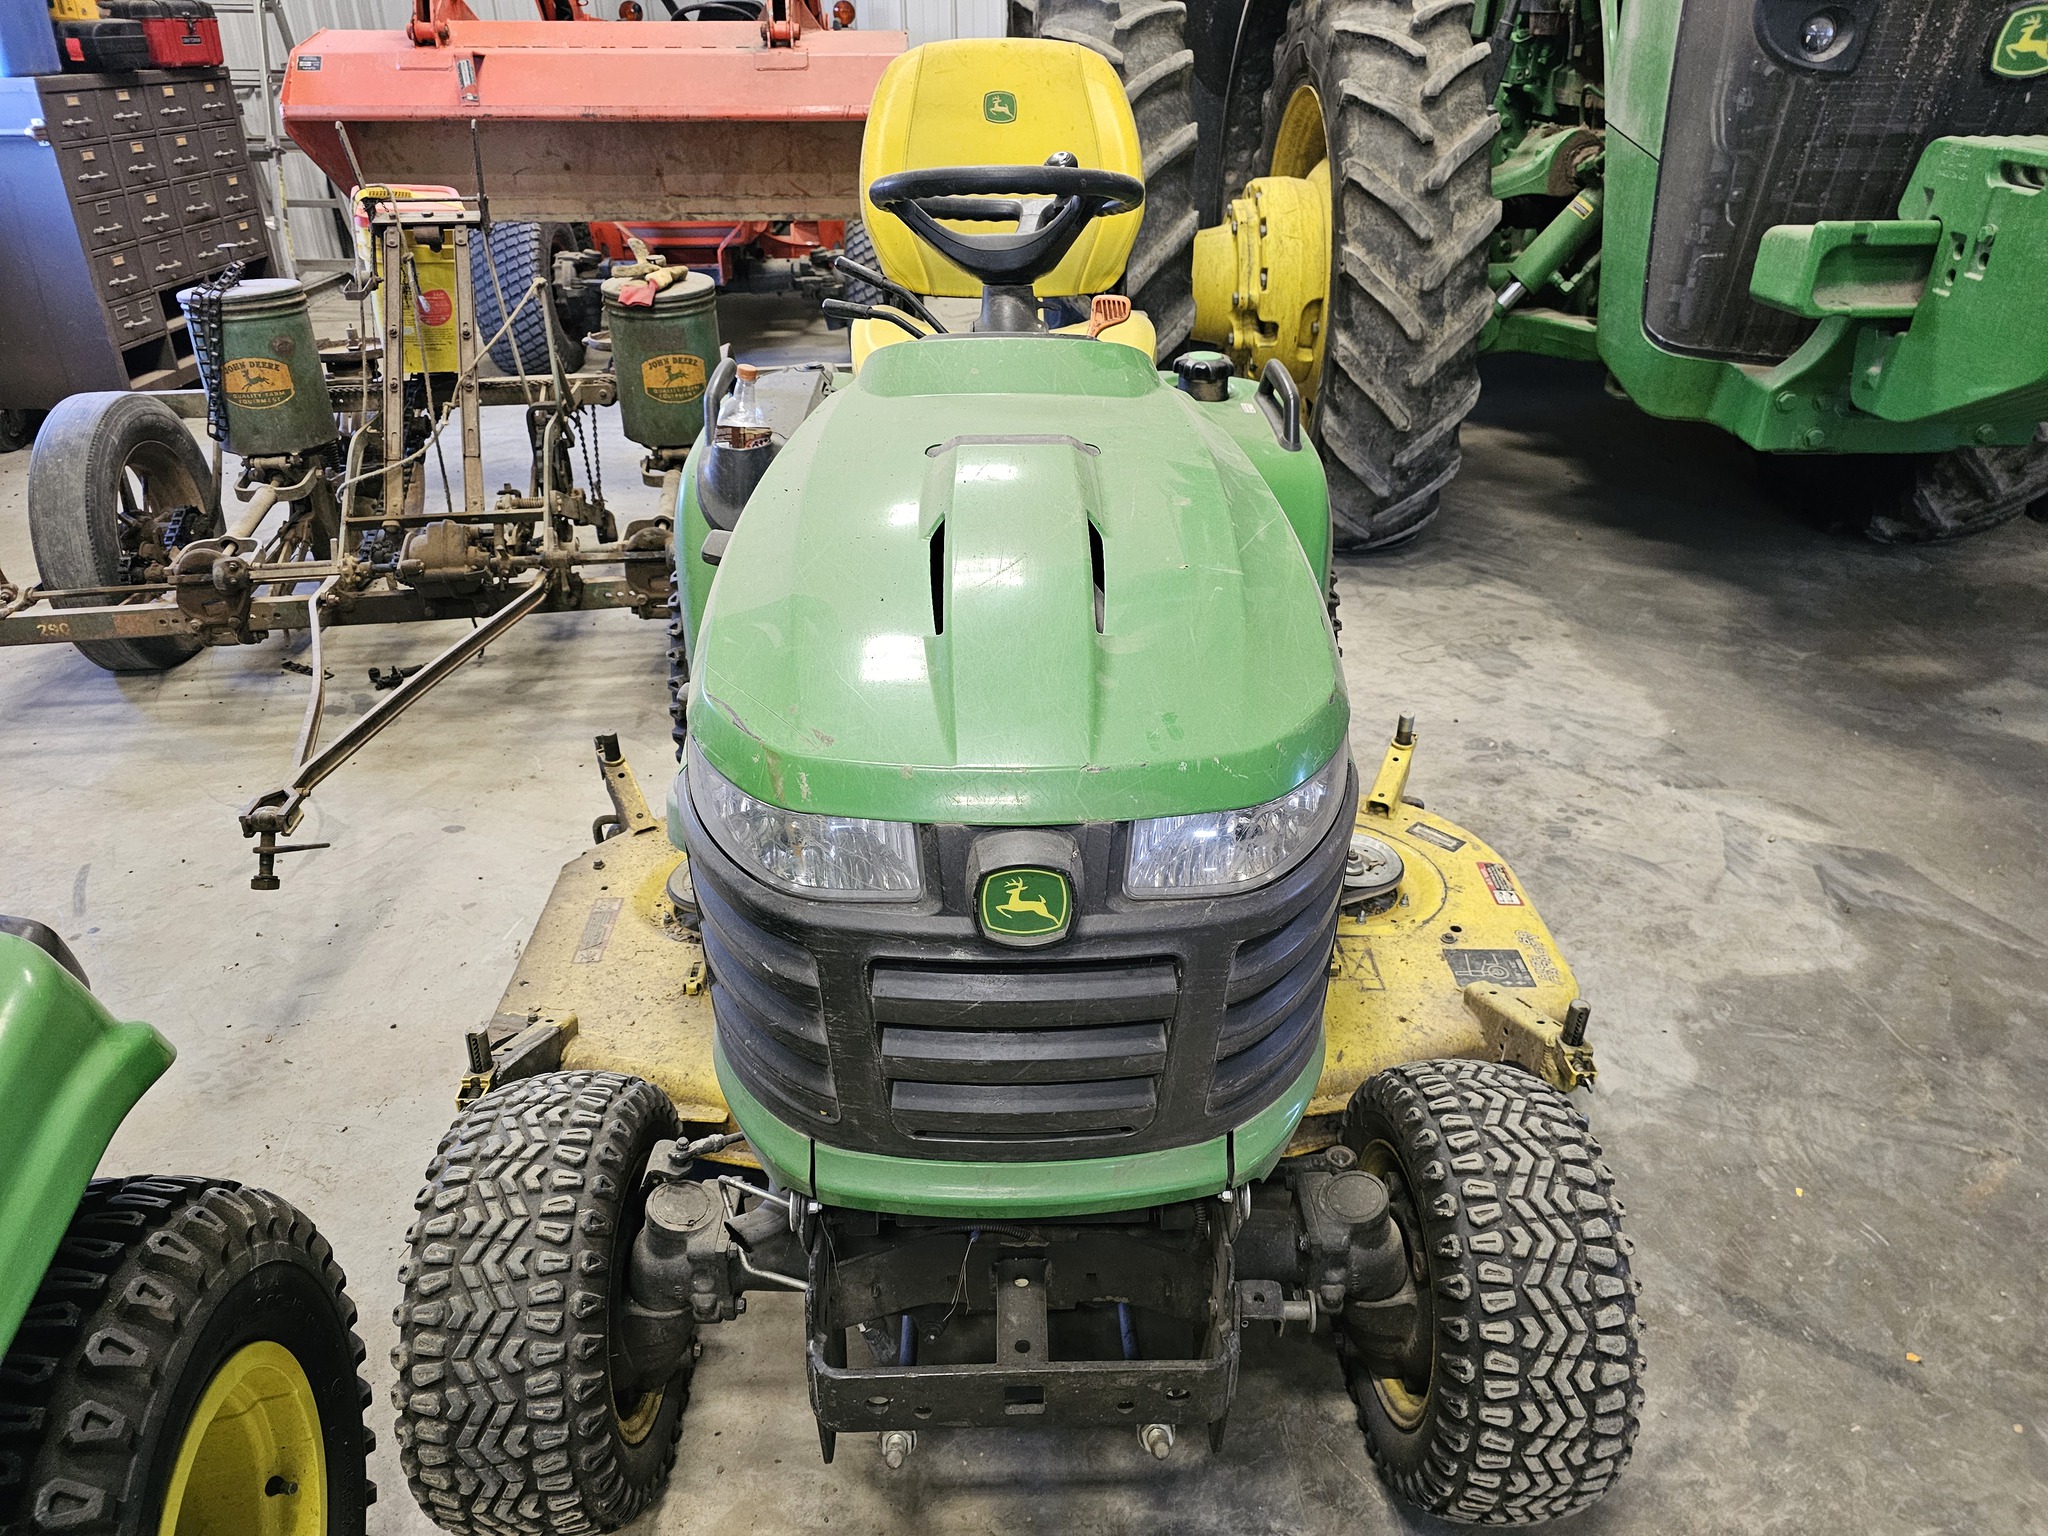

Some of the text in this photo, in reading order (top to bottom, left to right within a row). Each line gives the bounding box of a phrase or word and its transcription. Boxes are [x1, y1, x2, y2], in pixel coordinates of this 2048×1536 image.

[224, 361, 280, 375] JOHN DEERE
[648, 357, 698, 370] JOHN DEERE
[238, 396, 281, 404] EQUIPMENT
[659, 391, 697, 399] EQUIPMENT
